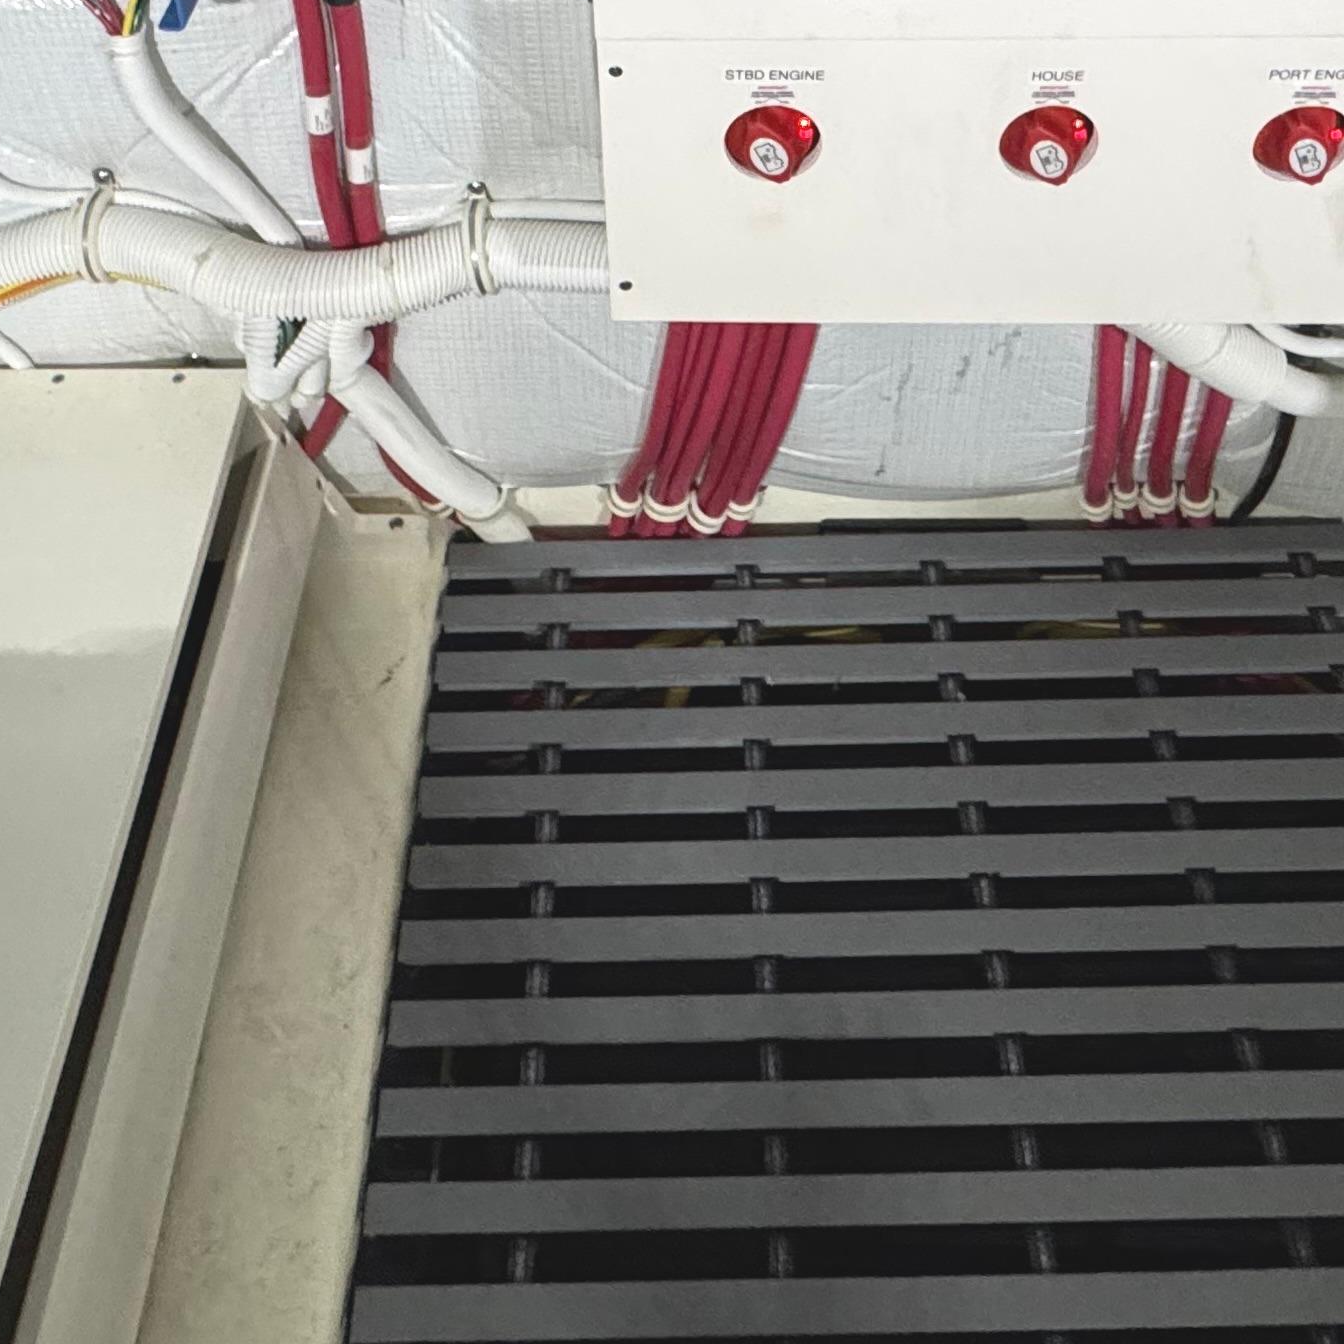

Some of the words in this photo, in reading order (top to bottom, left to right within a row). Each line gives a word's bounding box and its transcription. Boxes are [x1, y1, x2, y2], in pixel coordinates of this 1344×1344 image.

[725, 69, 765, 81] STBD
[769, 69, 825, 81] ENGINE
[1031, 70, 1085, 81] HOUSE
[1268, 69, 1312, 80] PORT
